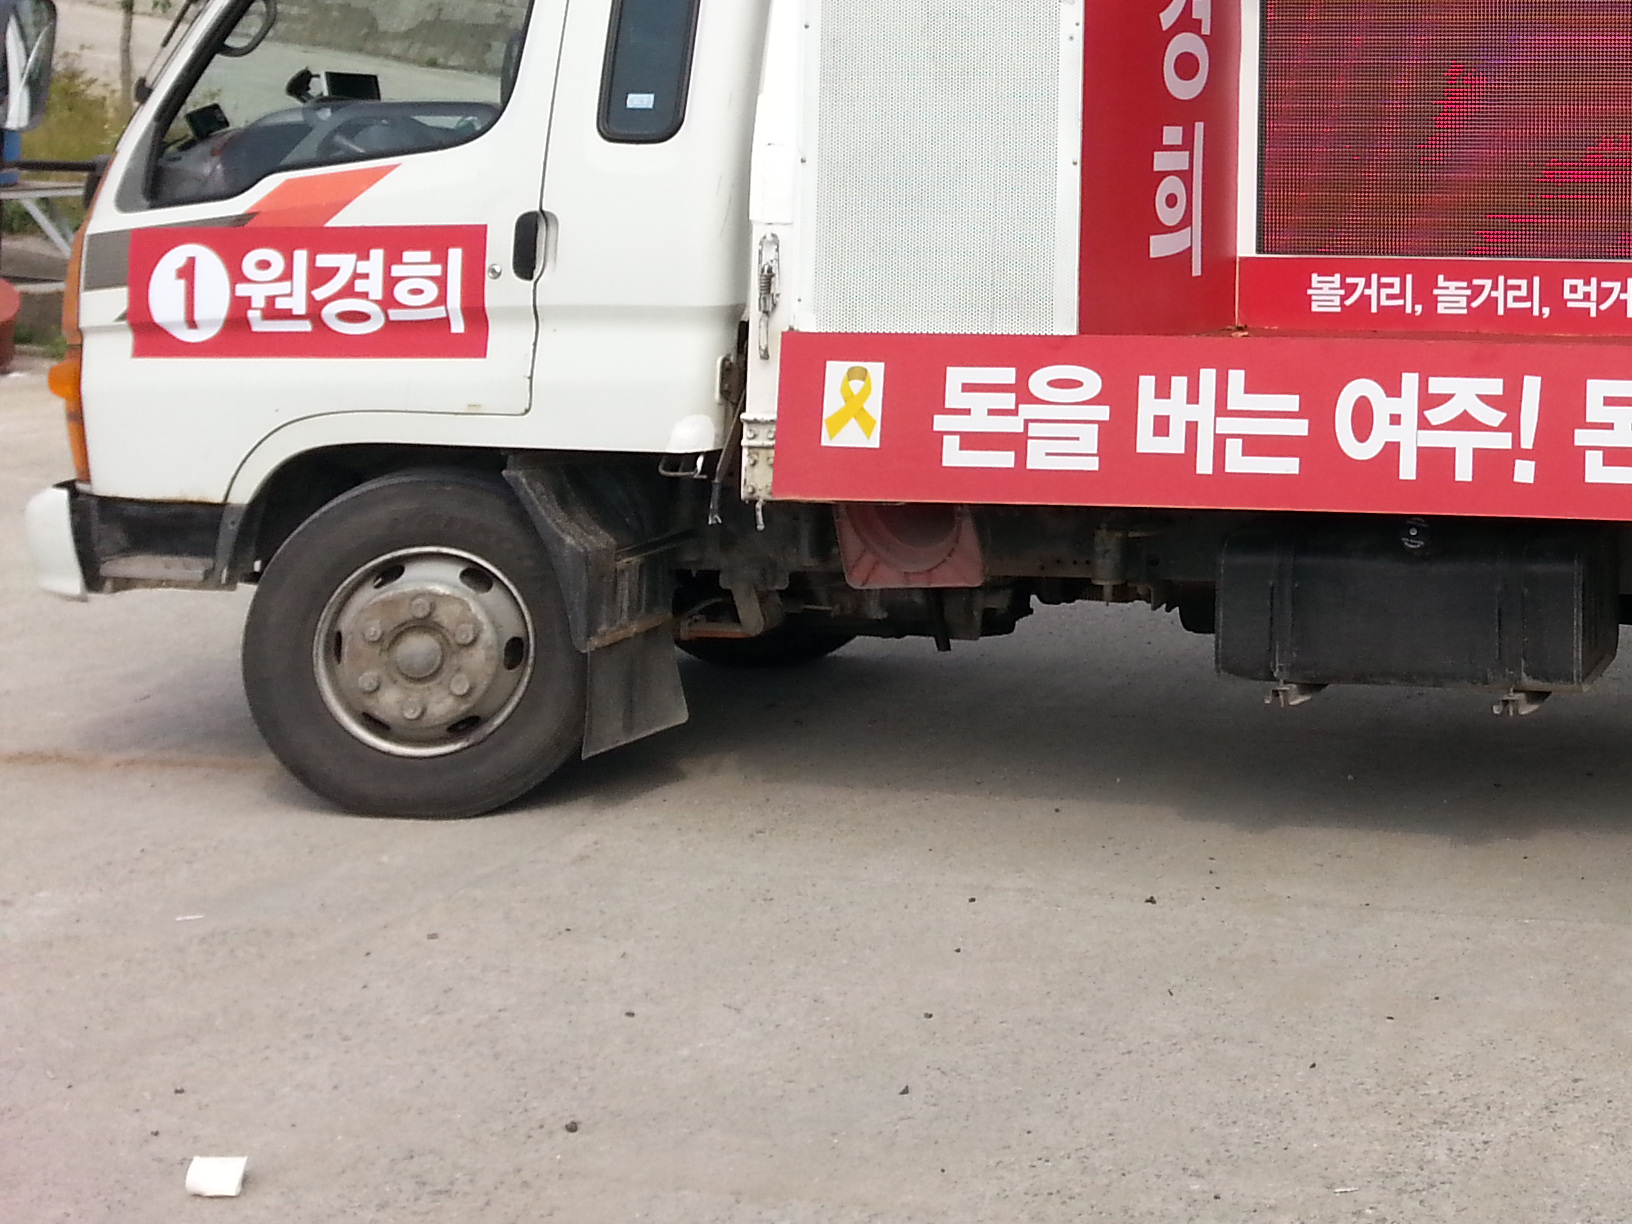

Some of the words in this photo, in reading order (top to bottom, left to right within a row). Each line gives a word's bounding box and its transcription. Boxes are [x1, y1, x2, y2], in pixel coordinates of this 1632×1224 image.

[235, 248, 465, 335] 원경희
[1307, 273, 1423, 316] 볼거리,
[1433, 274, 1550, 319] 놀거리,
[933, 364, 1110, 471] 돈을
[1135, 368, 1309, 474] 버는
[1334, 372, 1542, 484] 여주!
